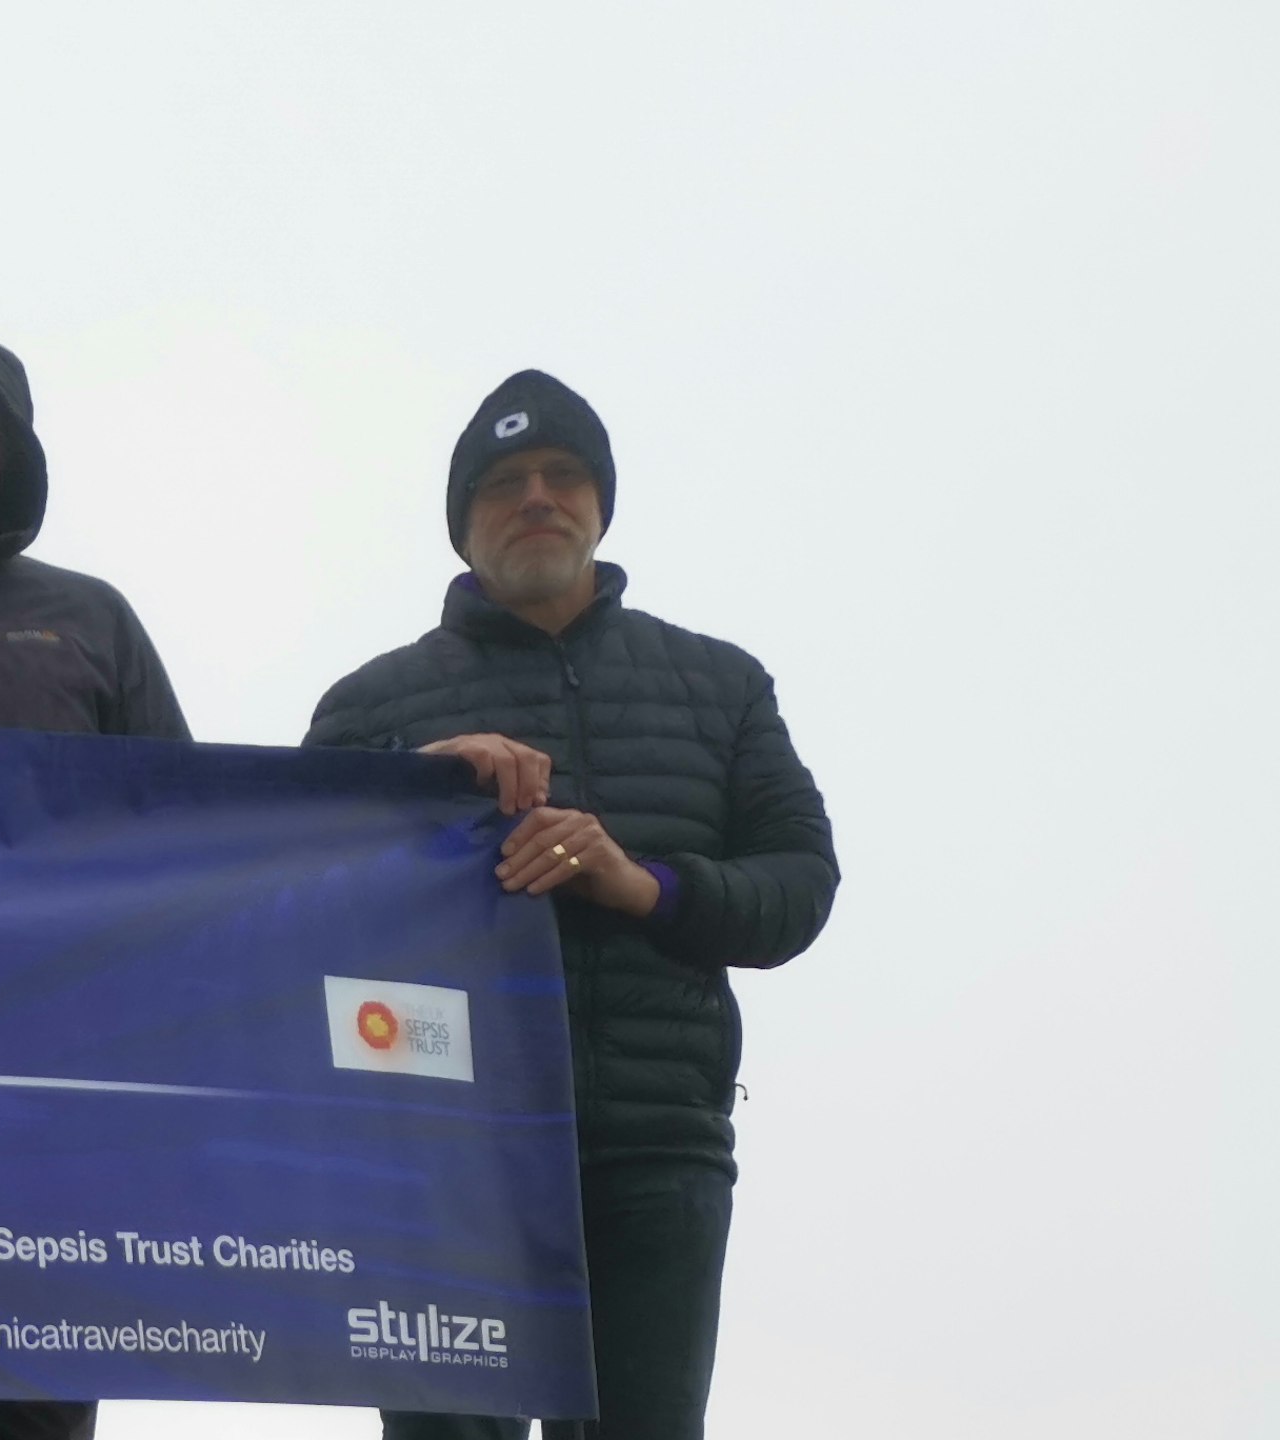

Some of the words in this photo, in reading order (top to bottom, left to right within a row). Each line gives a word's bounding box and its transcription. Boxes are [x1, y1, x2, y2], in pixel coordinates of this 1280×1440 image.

[405, 1018, 450, 1040] SEPSIS
[408, 1037, 451, 1057] TRUST
[115, 1231, 205, 1267] Trust
[212, 1234, 356, 1274] Charities
[347, 1300, 508, 1362] stylize
[351, 1345, 417, 1361] DISPLAY
[431, 1351, 509, 1369] GRAPHICS
